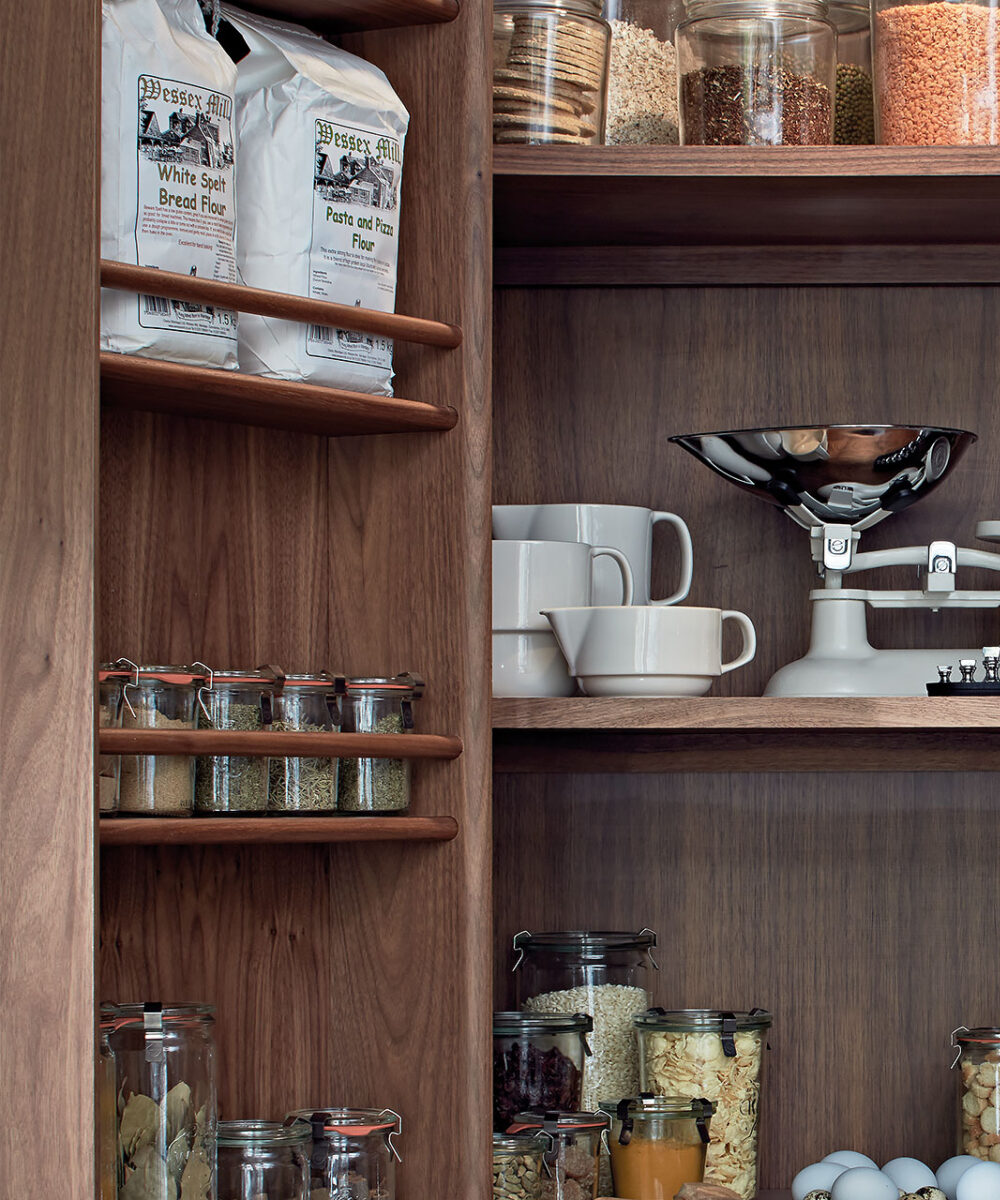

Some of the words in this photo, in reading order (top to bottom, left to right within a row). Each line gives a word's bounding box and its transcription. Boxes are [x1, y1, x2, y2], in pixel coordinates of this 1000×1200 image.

[140, 77, 202, 110] Wessex
[205, 93, 230, 119] Mill
[316, 121, 371, 155] Wessex
[376, 137, 401, 165] Mill
[157, 162, 197, 186] White
[201, 172, 226, 195] Spelt
[159, 188, 197, 211] Bread
[201, 194, 227, 217] Flour
[326, 206, 354, 231] Pasta
[357, 216, 373, 231] and
[375, 217, 394, 237] Pizza
[352, 233, 375, 252] Flour
[217, 313, 229, 326] 1.5
[375, 340, 385, 351] 1.5
